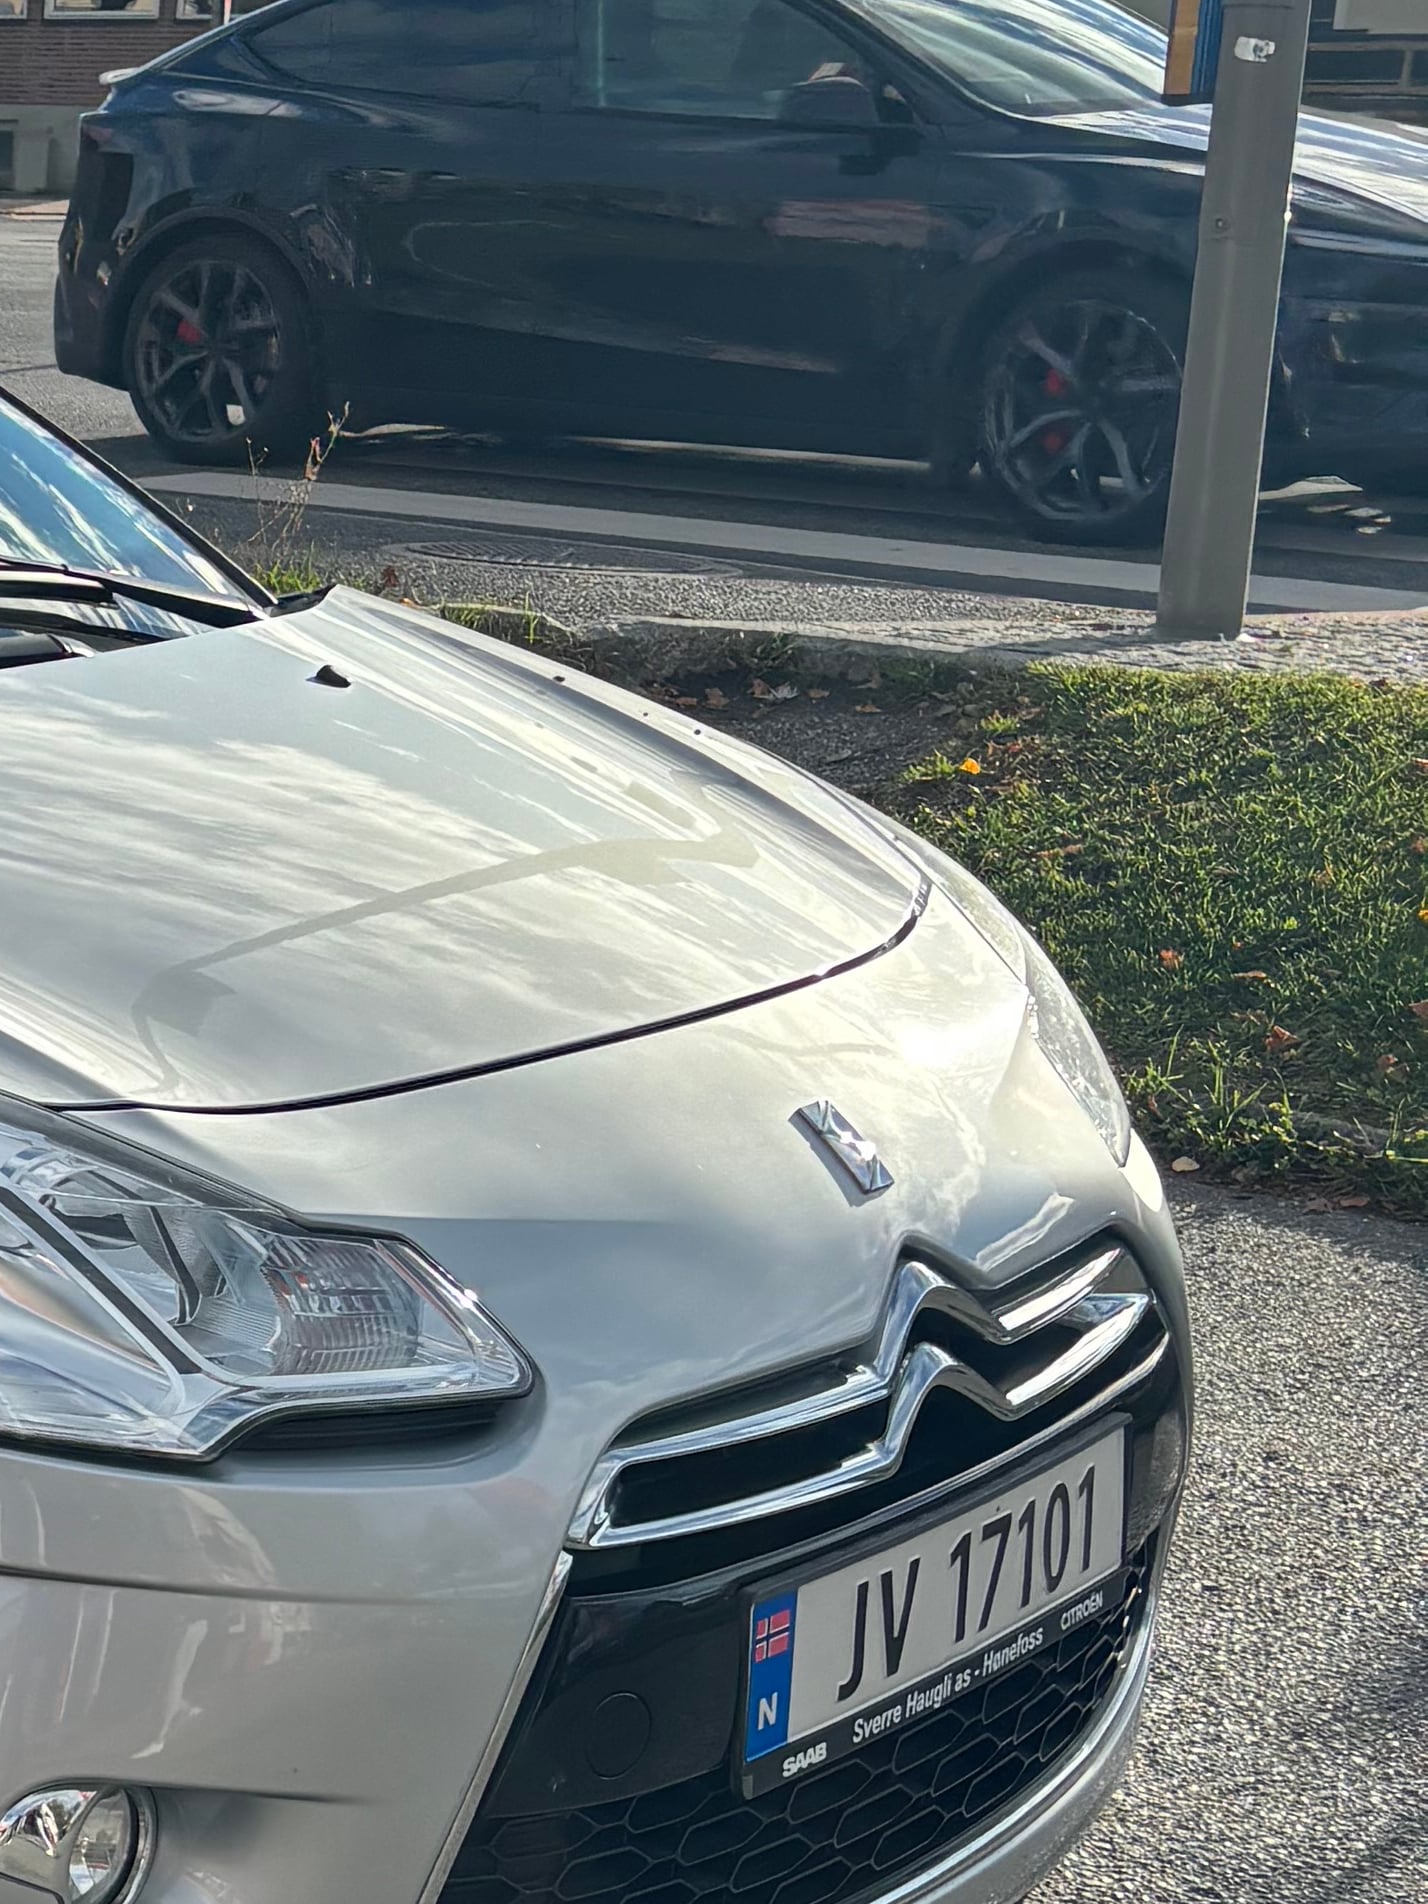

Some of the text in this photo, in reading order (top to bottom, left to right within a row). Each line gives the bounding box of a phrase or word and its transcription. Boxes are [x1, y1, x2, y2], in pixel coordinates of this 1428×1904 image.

[837, 1464, 1095, 1701] JV 17101
[758, 1692, 778, 1730] N
[853, 1705, 901, 1743] Sverre
[906, 1673, 952, 1719] Haugli
[954, 1669, 972, 1691] as
[982, 1627, 1043, 1677] Hønefoss
[783, 1742, 827, 1777] SAAB
